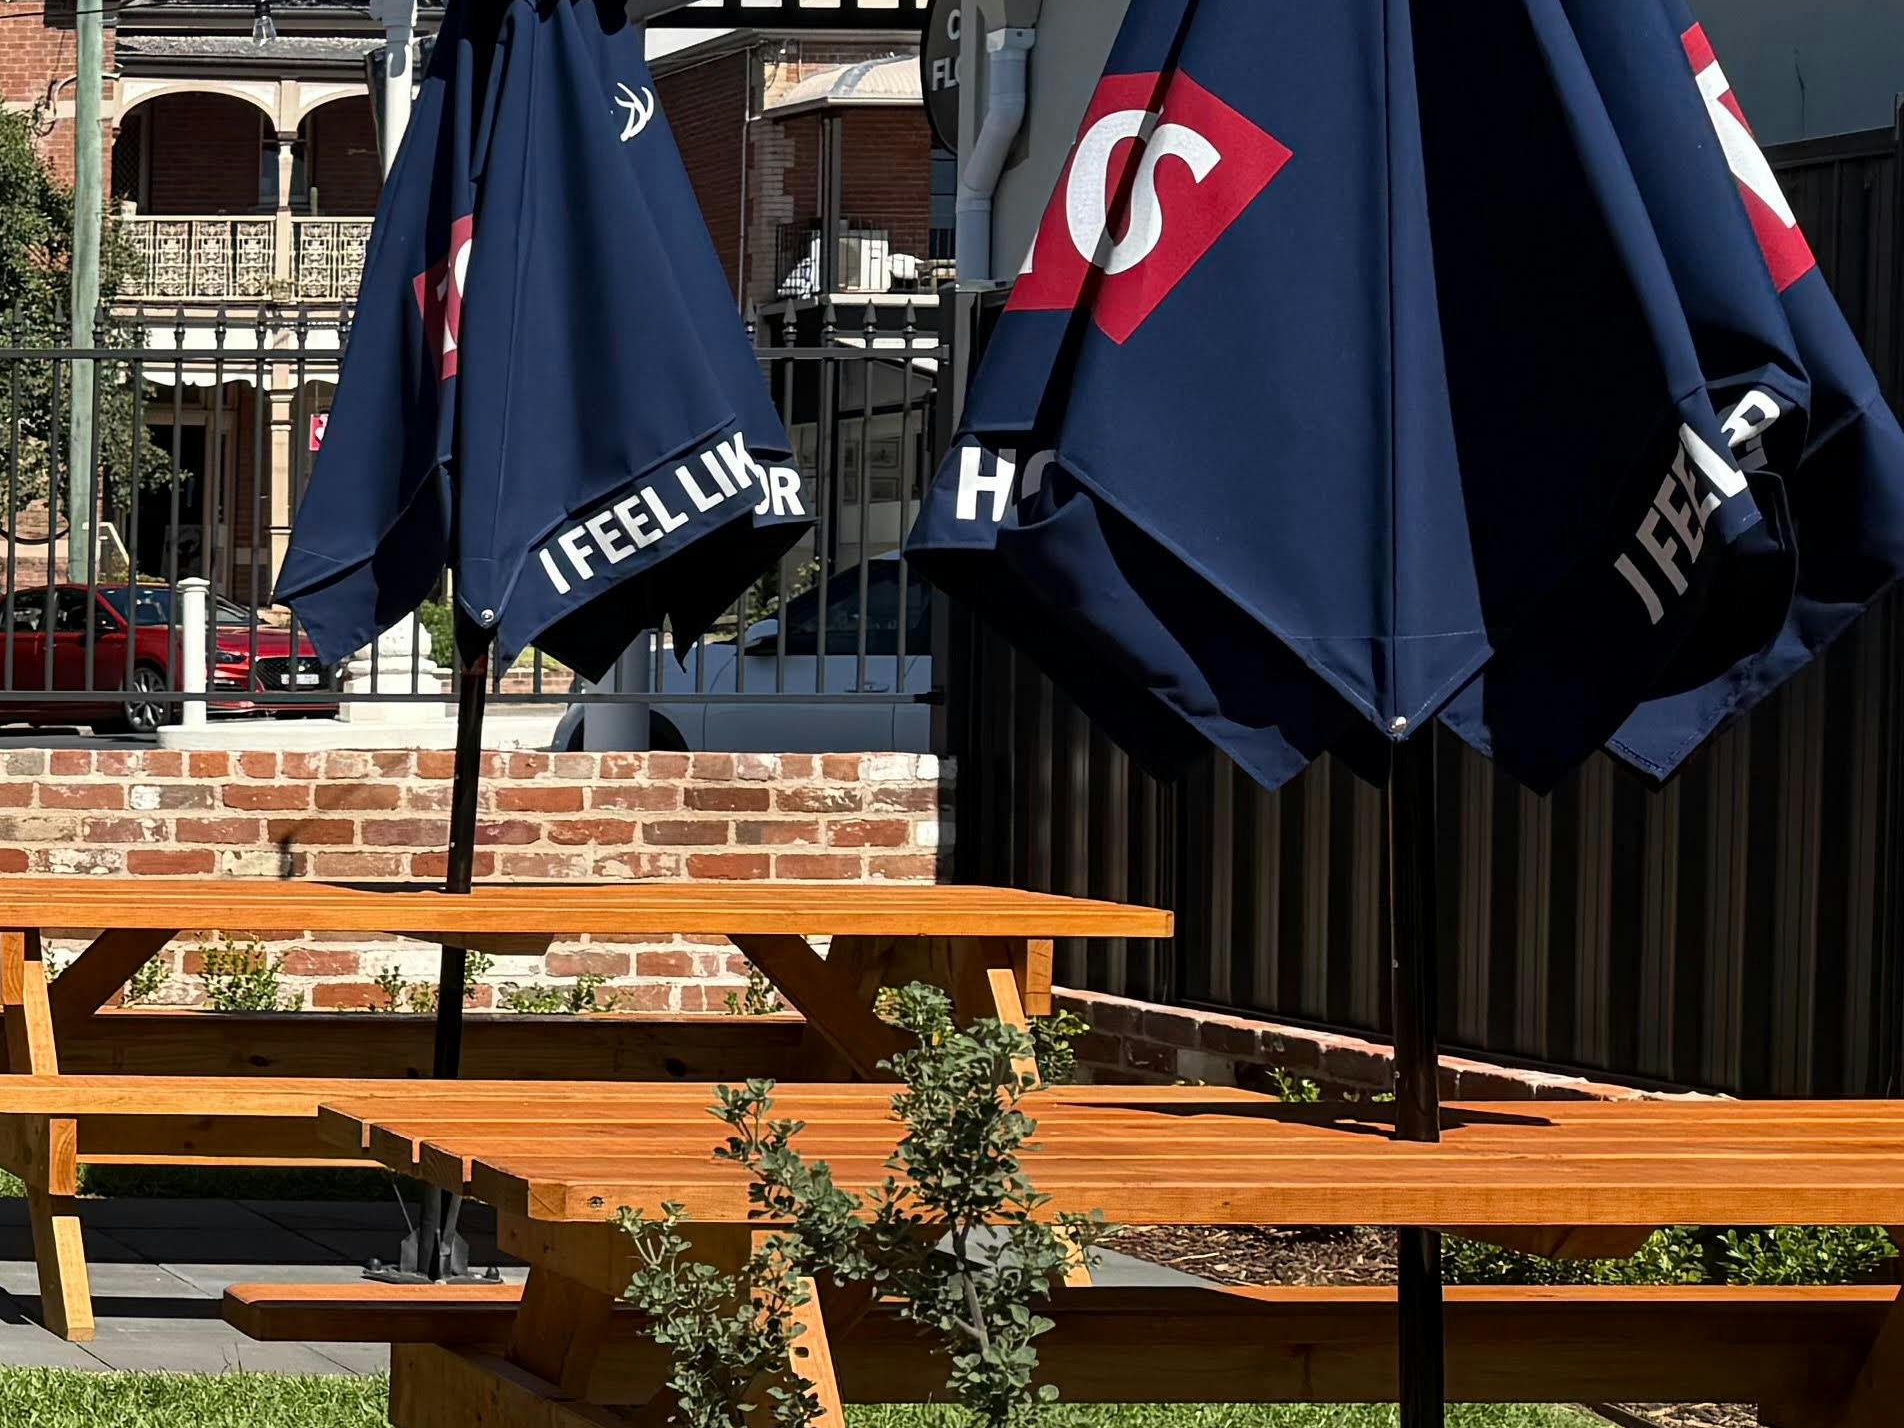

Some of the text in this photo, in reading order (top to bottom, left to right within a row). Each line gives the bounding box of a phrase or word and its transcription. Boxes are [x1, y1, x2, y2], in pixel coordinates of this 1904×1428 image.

[539, 548, 571, 595] I
[557, 485, 690, 581] FEEL
[674, 431, 762, 513] LIK
